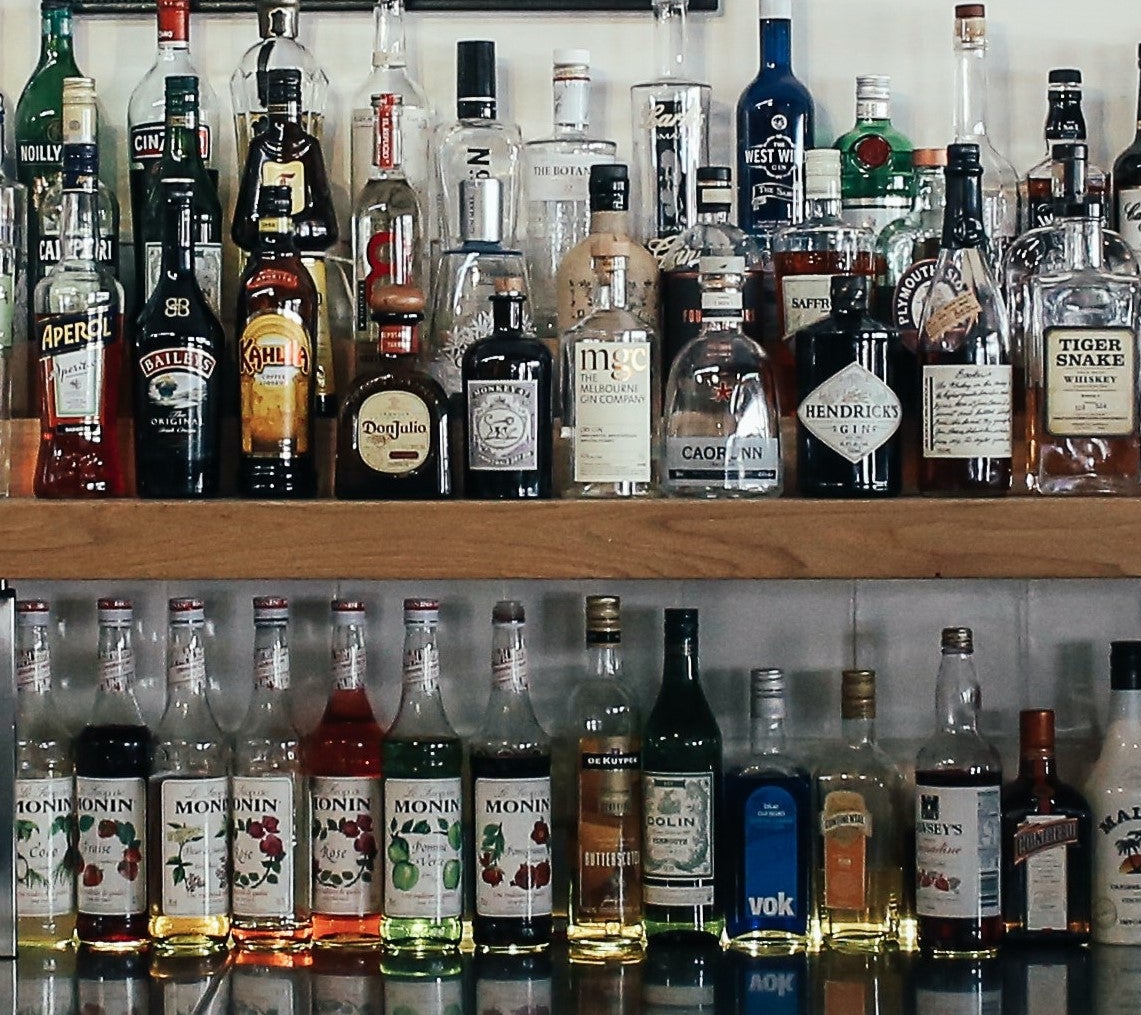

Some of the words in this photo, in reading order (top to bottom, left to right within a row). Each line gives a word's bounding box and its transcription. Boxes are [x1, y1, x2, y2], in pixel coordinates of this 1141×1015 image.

[21, 145, 62, 162] NOILLY
[745, 149, 774, 163] WEST
[792, 297, 830, 309] SAFFR
[42, 318, 111, 350] APEROL
[1059, 338, 1122, 351] TIGER
[581, 348, 647, 381] mgc
[1056, 354, 1125, 367] SNAKE
[1063, 376, 1117, 384] WHISKEY
[806, 405, 898, 418] HENDRICK'S
[395, 800, 459, 813] MONIN
[486, 800, 550, 813] MONIN
[320, 844, 347, 863] Rose
[748, 892, 795, 917] vok
